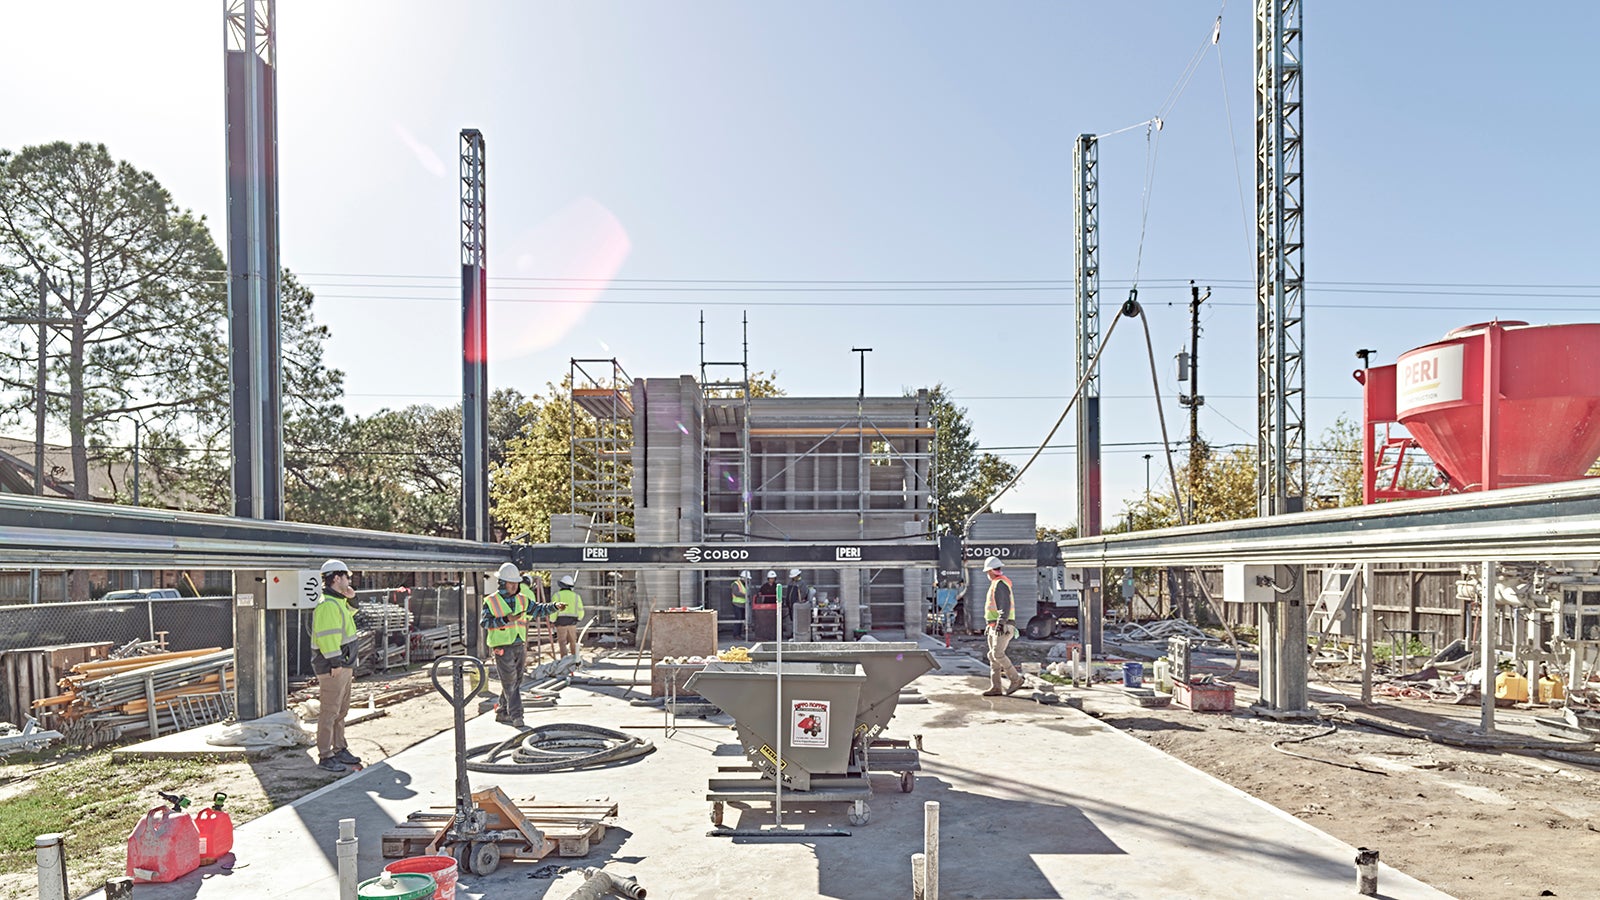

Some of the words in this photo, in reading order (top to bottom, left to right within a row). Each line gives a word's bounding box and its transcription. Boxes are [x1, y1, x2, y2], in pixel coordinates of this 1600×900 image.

[1404, 356, 1439, 386] PERI
[586, 547, 608, 558] PERI
[703, 550, 749, 559] COBOD
[839, 547, 861, 557] PERI
[966, 547, 1010, 557] COBOD
